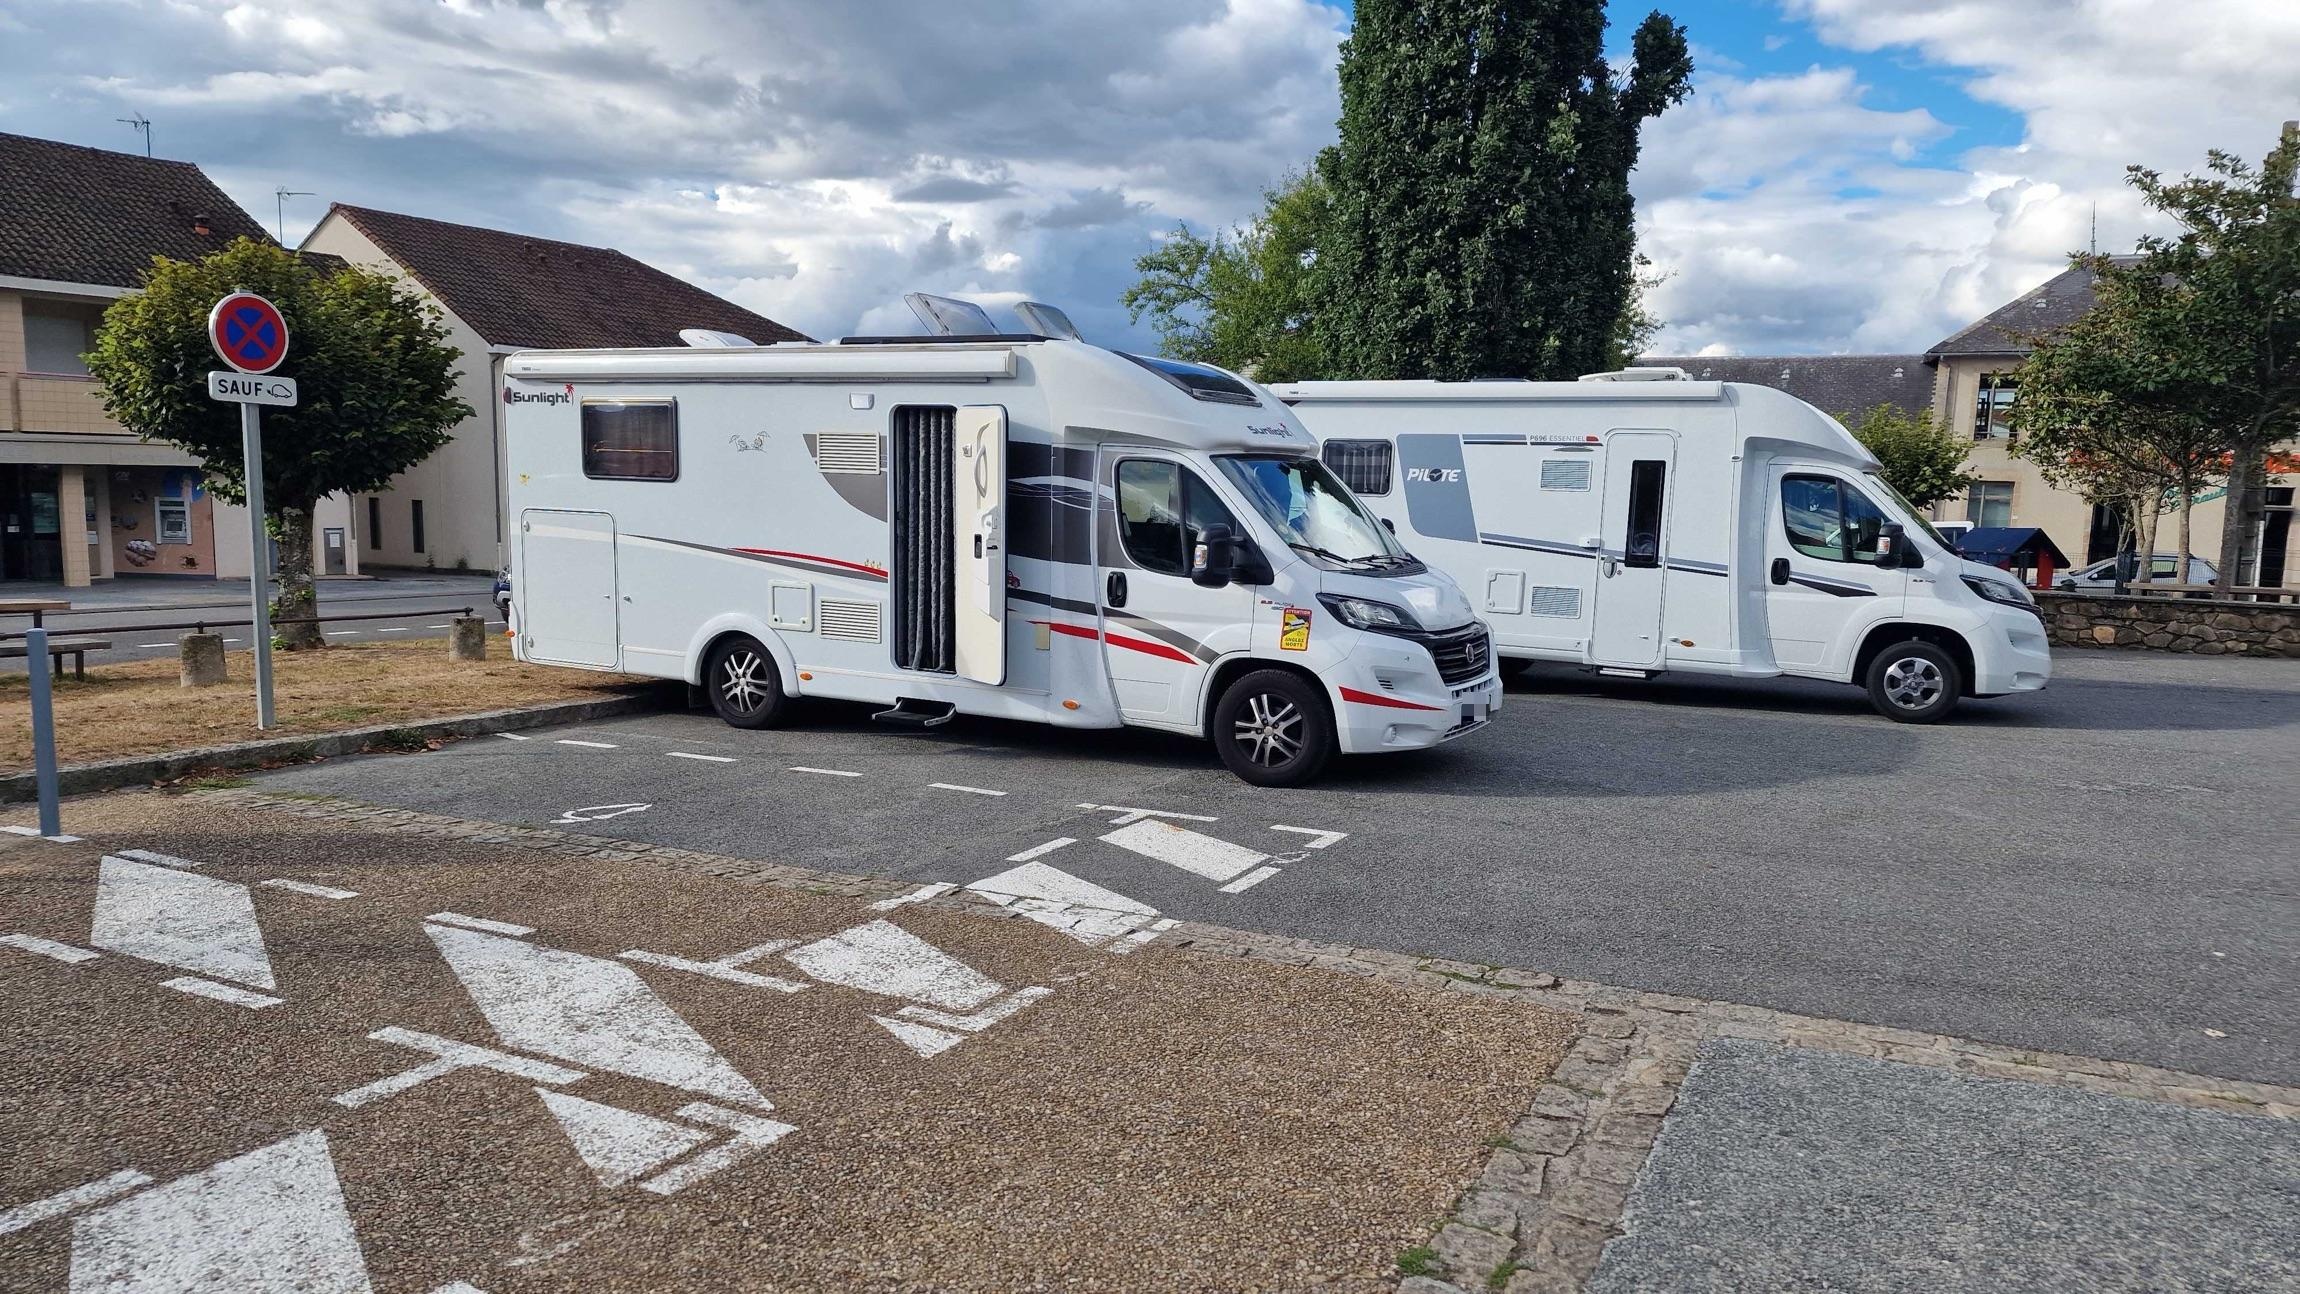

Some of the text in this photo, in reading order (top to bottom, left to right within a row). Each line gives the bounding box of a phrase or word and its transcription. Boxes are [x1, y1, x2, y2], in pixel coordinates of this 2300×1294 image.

[218, 379, 263, 396] SAUF
[513, 390, 571, 406] Sunlight
[1247, 425, 1293, 439] Sunlight
[1549, 434, 1585, 442] ESSENTIEL
